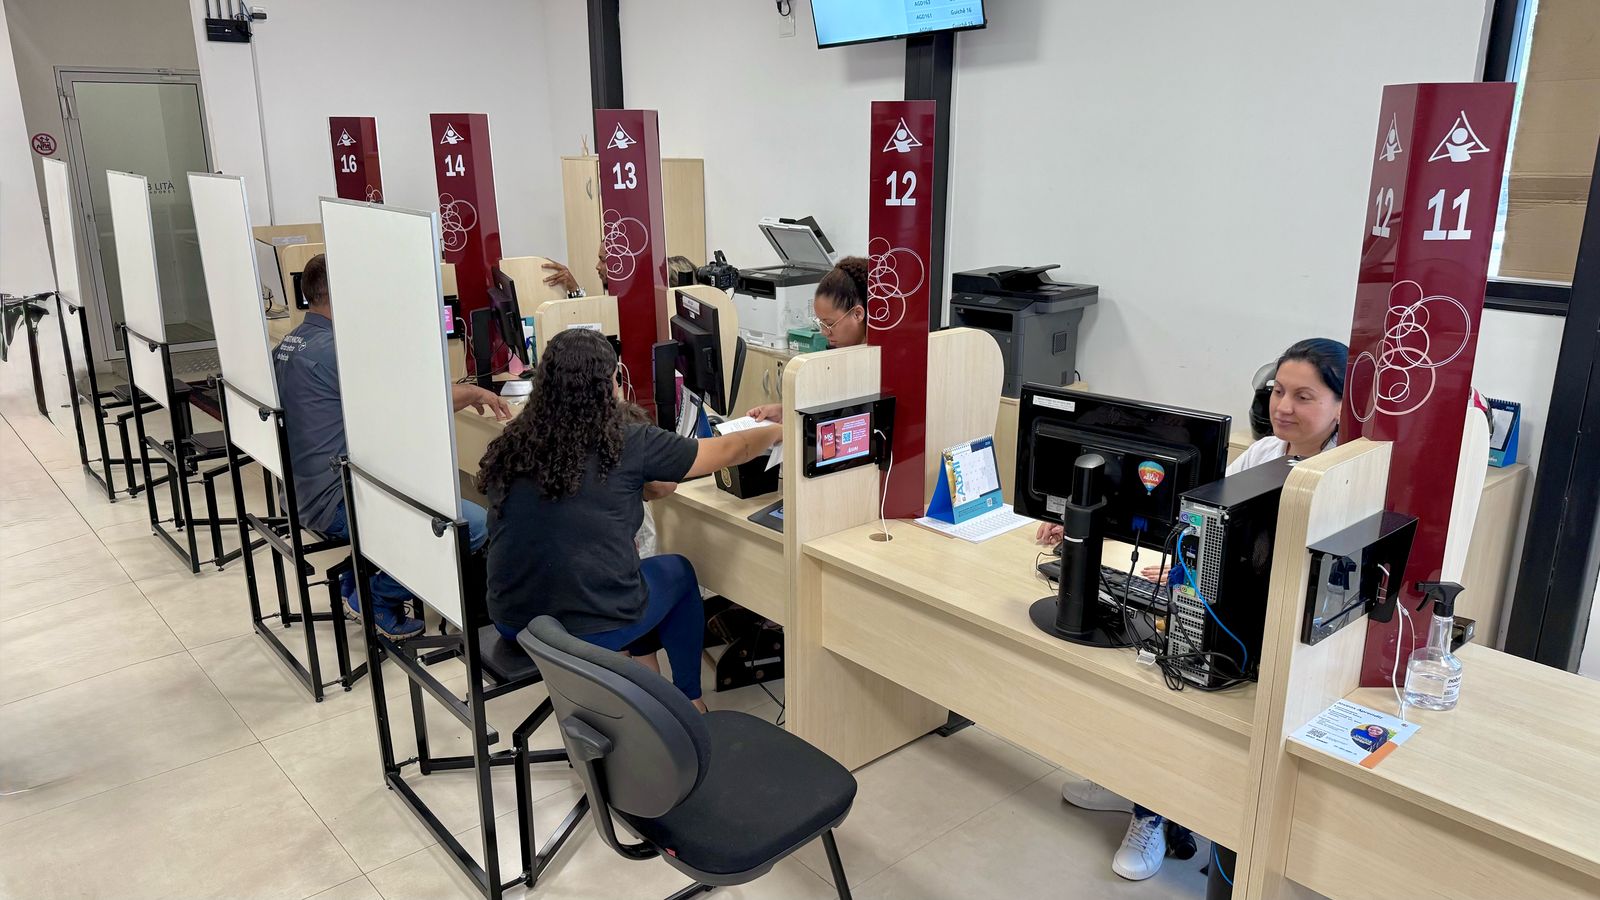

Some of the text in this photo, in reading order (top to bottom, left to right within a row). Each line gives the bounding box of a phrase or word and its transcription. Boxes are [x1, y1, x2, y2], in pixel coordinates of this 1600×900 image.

[341, 155, 357, 173] 16
[445, 155, 465, 177] 14
[613, 162, 637, 190] 13
[886, 171, 917, 206] 12
[1372, 186, 1394, 238] 12
[1423, 189, 1472, 241] 11
[953, 461, 966, 496] Abril
